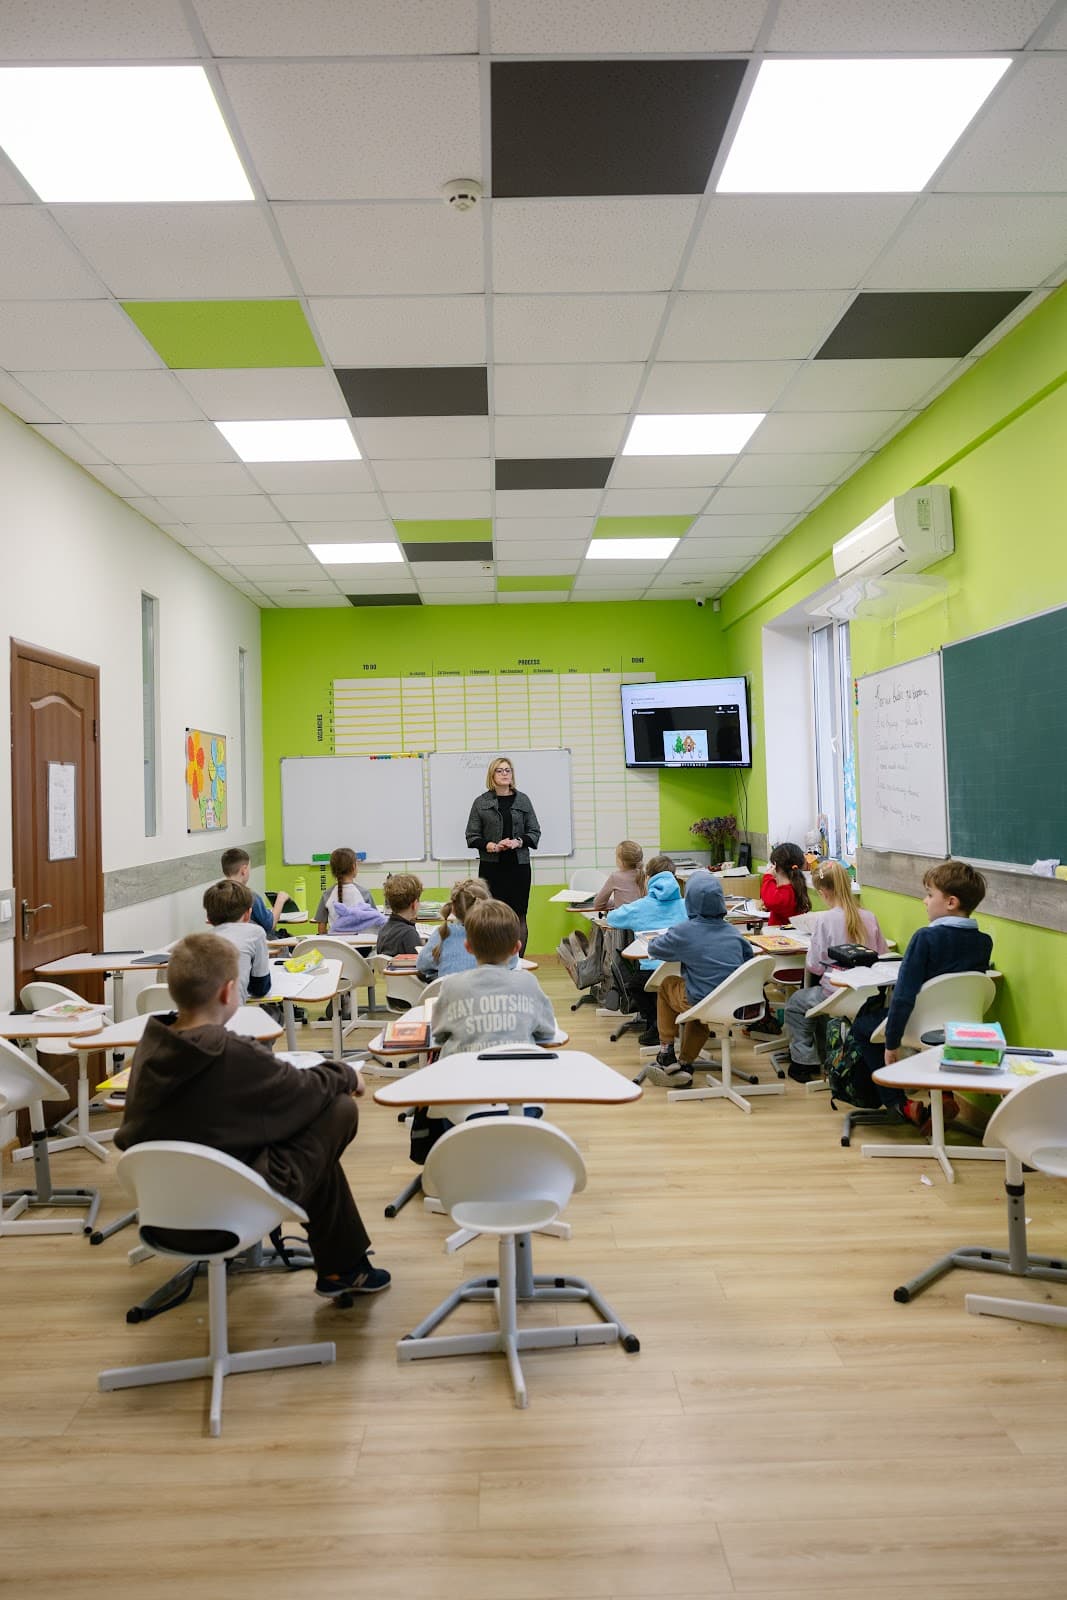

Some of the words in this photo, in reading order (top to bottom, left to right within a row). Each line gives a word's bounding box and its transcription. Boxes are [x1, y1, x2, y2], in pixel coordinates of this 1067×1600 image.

[447, 998, 474, 1021] STAY
[479, 993, 534, 1014] OUTSIDE
[465, 1013, 517, 1034] STUDIO
